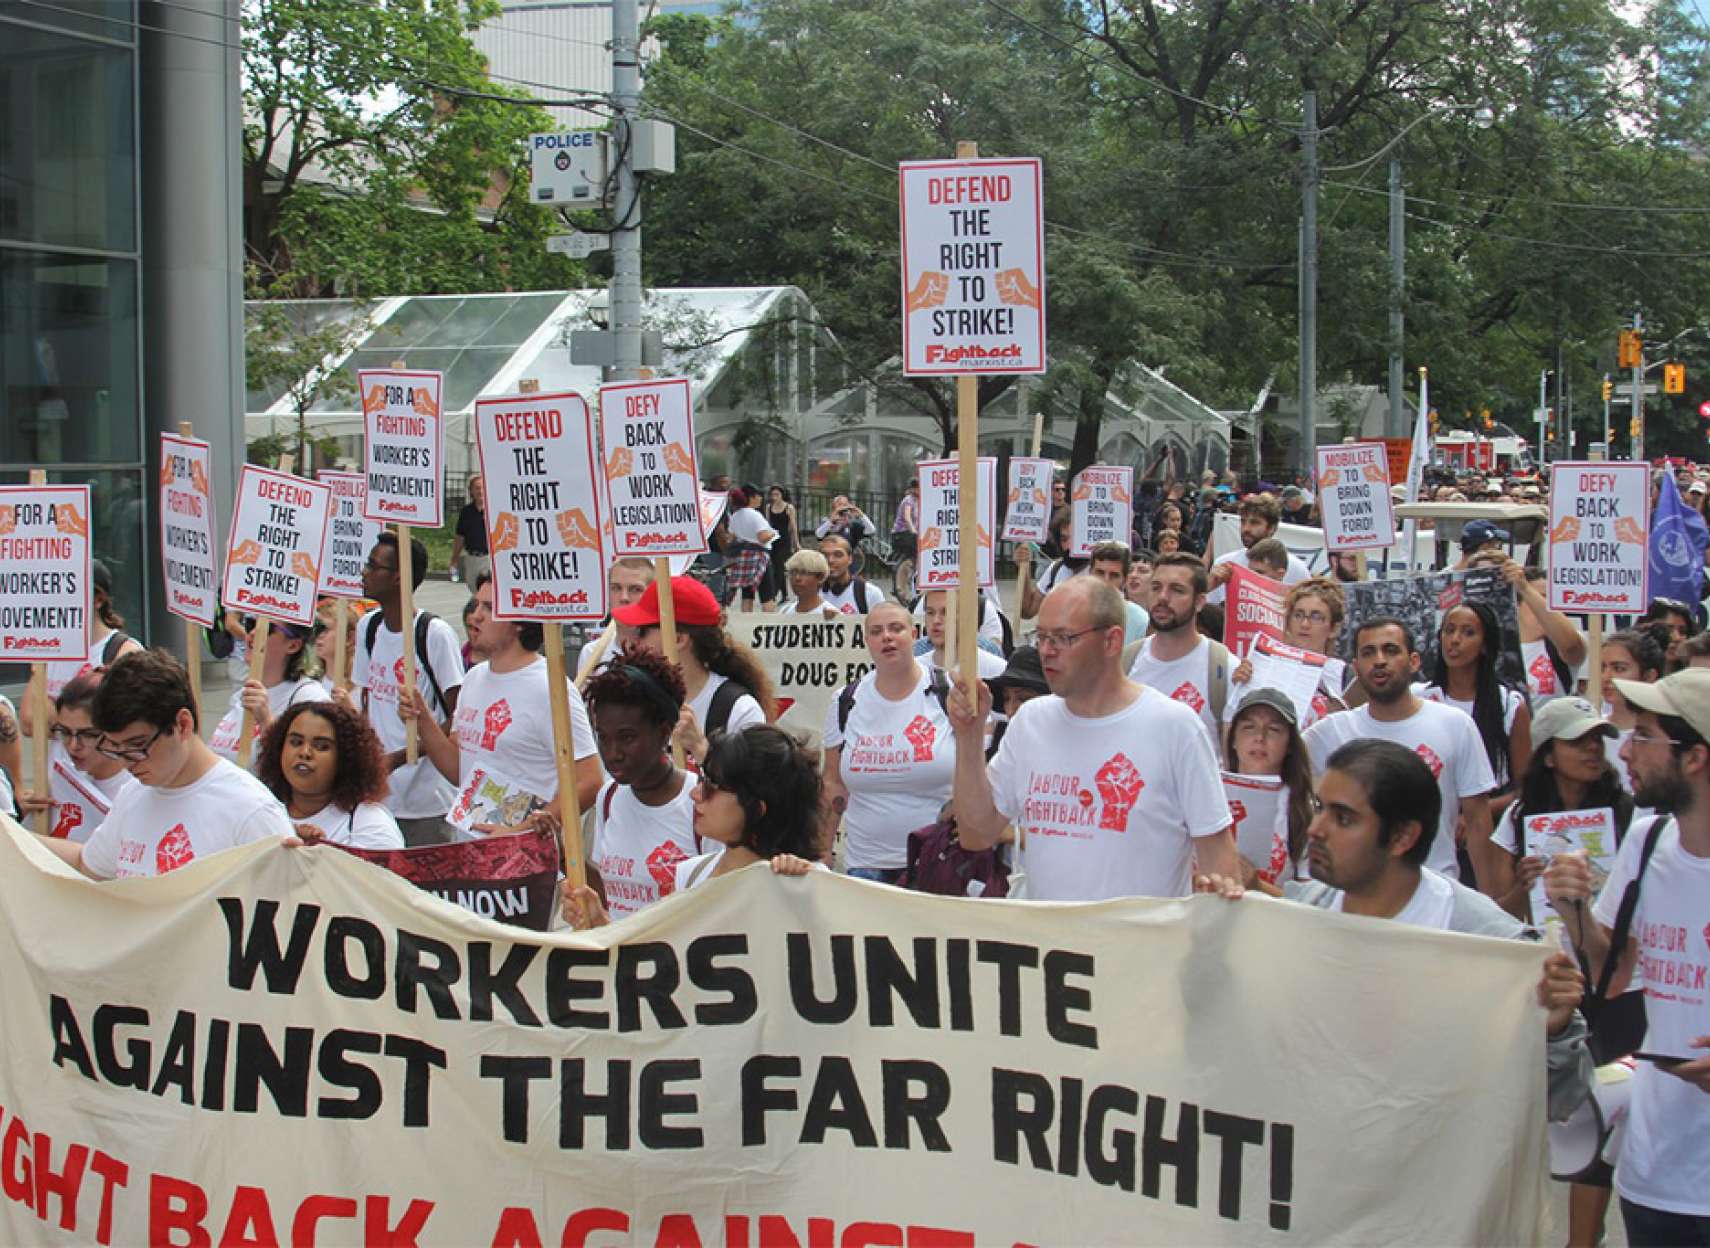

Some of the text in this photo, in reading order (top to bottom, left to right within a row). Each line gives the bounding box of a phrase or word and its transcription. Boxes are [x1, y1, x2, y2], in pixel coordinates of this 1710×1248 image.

[535, 133, 593, 149] POLICE
[928, 175, 1012, 205] DEFEND
[949, 209, 991, 237] THE
[940, 242, 1003, 270] RIGHT
[958, 275, 986, 303] TO
[932, 308, 1014, 336] STRIKE!
[926, 344, 1021, 364] Fightback
[384, 384, 415, 406] FOR A
[625, 394, 660, 418] DEFY
[376, 414, 426, 437] FIGHTING
[495, 409, 562, 442] DEFEND
[625, 421, 666, 447] BACK
[373, 444, 430, 467] WORKER'S
[513, 447, 547, 476] THE
[640, 452, 656, 471] TO
[1325, 450, 1375, 467] MOBILIZE
[369, 474, 435, 498] MOVEMENT!
[628, 473, 674, 499] WORK
[932, 469, 960, 487] DEFE
[1344, 468, 1359, 482] TO
[1579, 473, 1616, 493] DEFY
[257, 479, 312, 508] DEFEND
[509, 481, 560, 511] RIGHT
[943, 489, 960, 507] TH
[1096, 487, 1107, 500] TO
[1337, 484, 1370, 500] BRING
[14, 504, 58, 525] FOR A
[270, 504, 297, 527] THE
[342, 500, 353, 517] TO
[613, 504, 696, 526] LEGISLATION!
[1340, 501, 1372, 516] DOWN
[1576, 498, 1620, 518] BACK
[257, 525, 300, 550] RIGHT
[334, 519, 362, 538] BRING
[525, 517, 548, 546] TO
[625, 531, 688, 548] Fightback
[1590, 524, 1605, 539] TO
[2, 537, 72, 560] FIGHTING
[267, 549, 285, 569] TO
[333, 539, 362, 557] DOWN
[932, 549, 960, 567] STRI
[1574, 543, 1620, 563] WORK
[511, 551, 579, 581] STRIKE!
[1553, 568, 1641, 586] LEGISLATION!
[244, 567, 300, 595] STRIKE!
[511, 588, 588, 608] Fightback
[1563, 591, 1629, 604] Fightback
[0, 606, 83, 629] OVEMENT!
[752, 624, 845, 649] STUDENTS
[781, 663, 838, 687] DOUG
[1024, 798, 1097, 826] FIGHTBACK
[457, 887, 529, 919] NOW
[217, 897, 1099, 1050] WORKERS UNITE
[50, 994, 1294, 1231] AGAINST THE FAR RIGHT!
[0, 1105, 128, 1246] GHT
